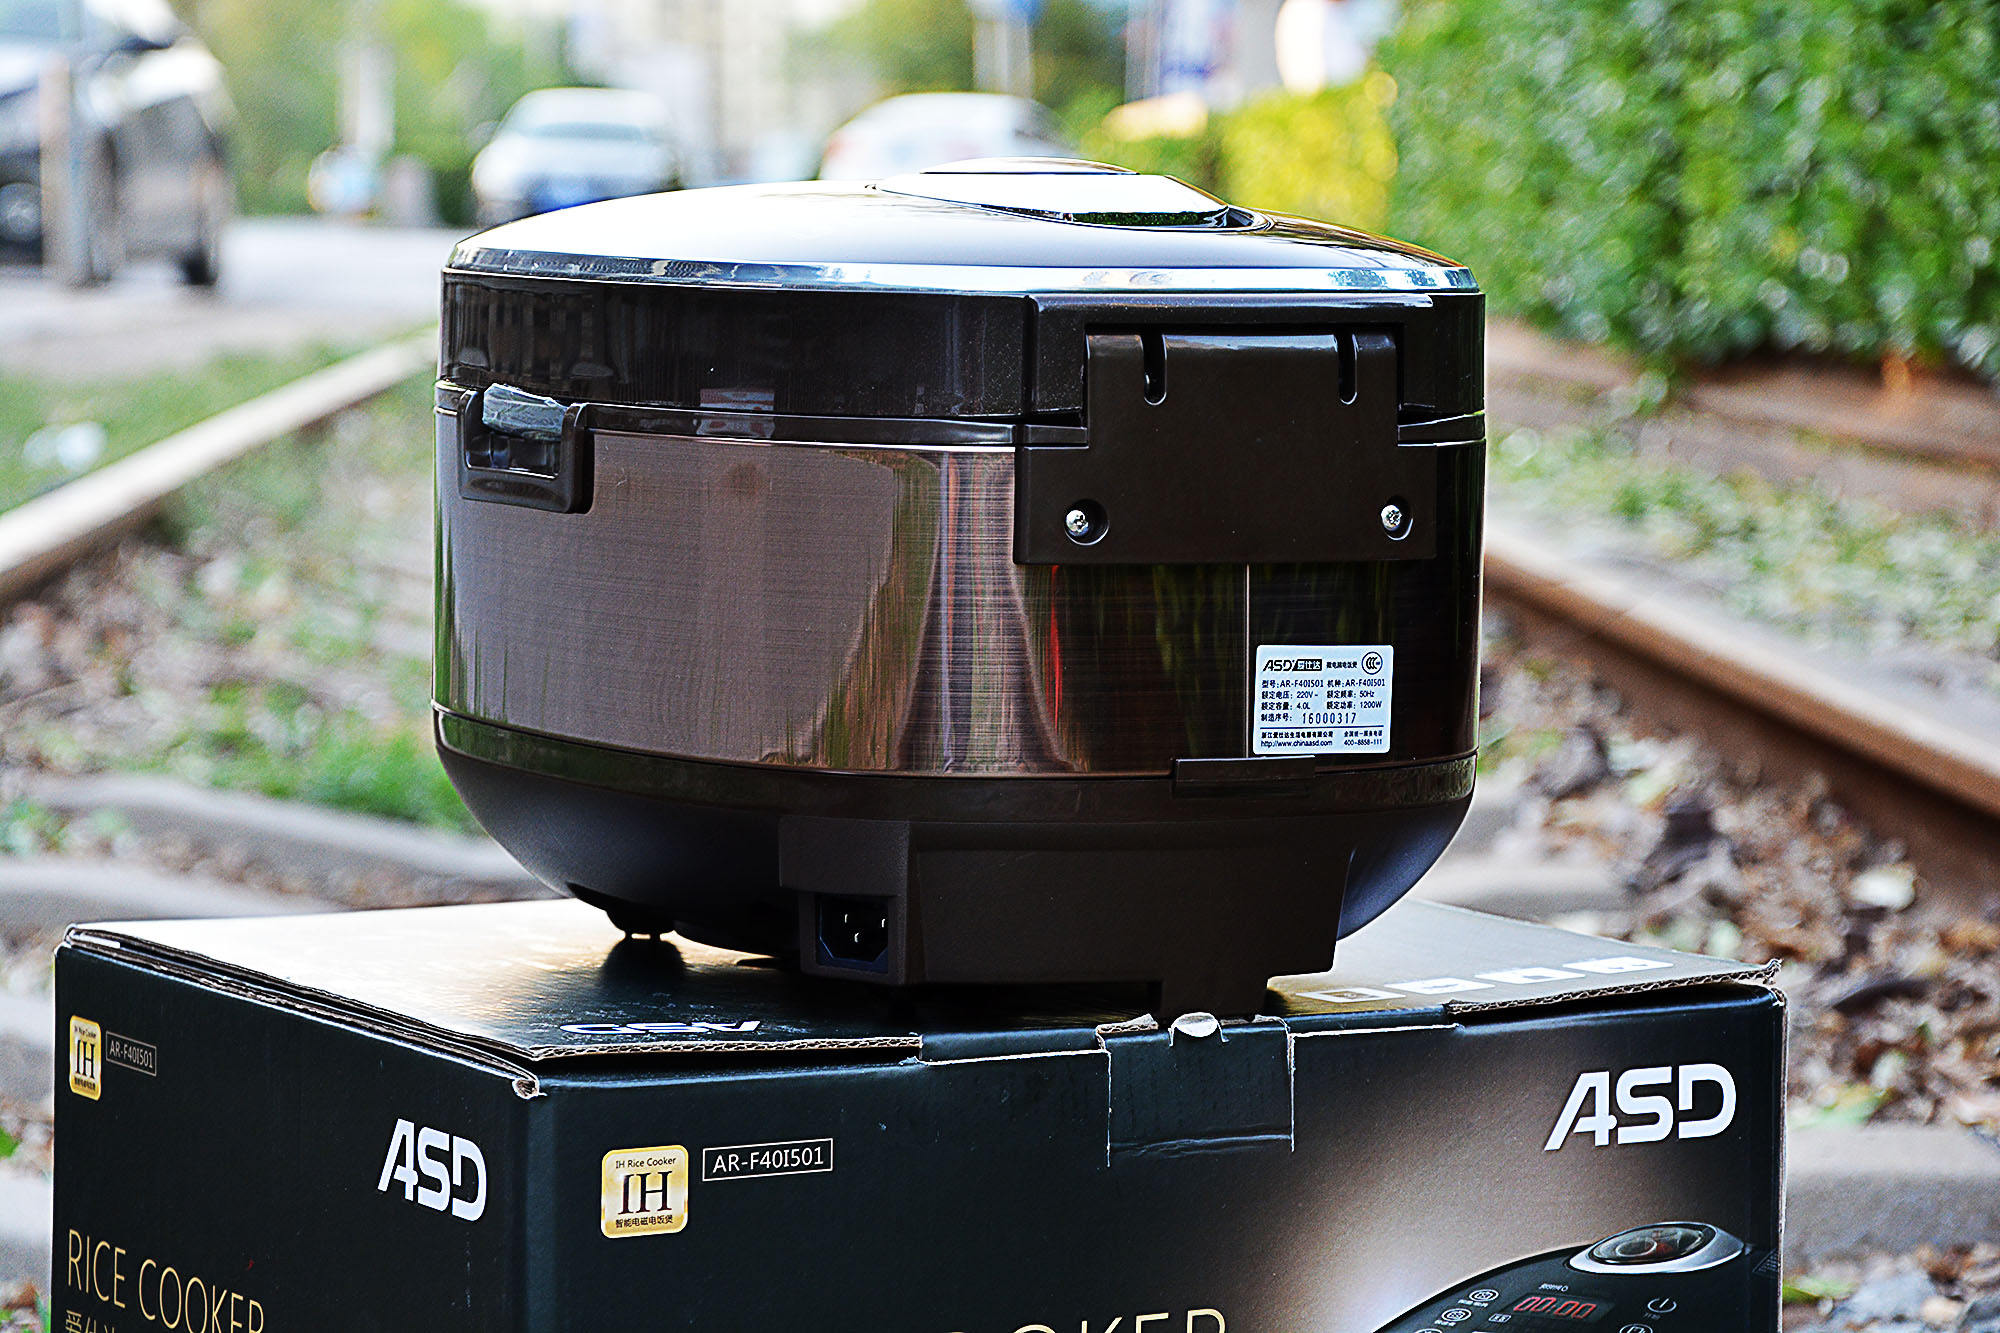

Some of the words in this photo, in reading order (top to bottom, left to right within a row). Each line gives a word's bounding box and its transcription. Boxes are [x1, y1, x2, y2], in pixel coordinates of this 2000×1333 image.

[1263, 659, 1293, 671] ASD
[1296, 702, 1311, 710] 4.0L
[1359, 700, 1383, 709] 1200W
[1302, 712, 1356, 724] 16000317
[1543, 1062, 1737, 1151] ASD
[377, 1118, 487, 1221] ASD
[615, 1160, 626, 1169] IH
[627, 1159, 645, 1168] Rice
[646, 1156, 677, 1167] Cooker
[712, 1146, 824, 1174] AR-F40I501
[617, 1170, 673, 1215] IH
[615, 1214, 673, 1229] 智能电磁电饭煲
[68, 1228, 127, 1309] RICE
[1512, 1295, 1598, 1319] 00:00
